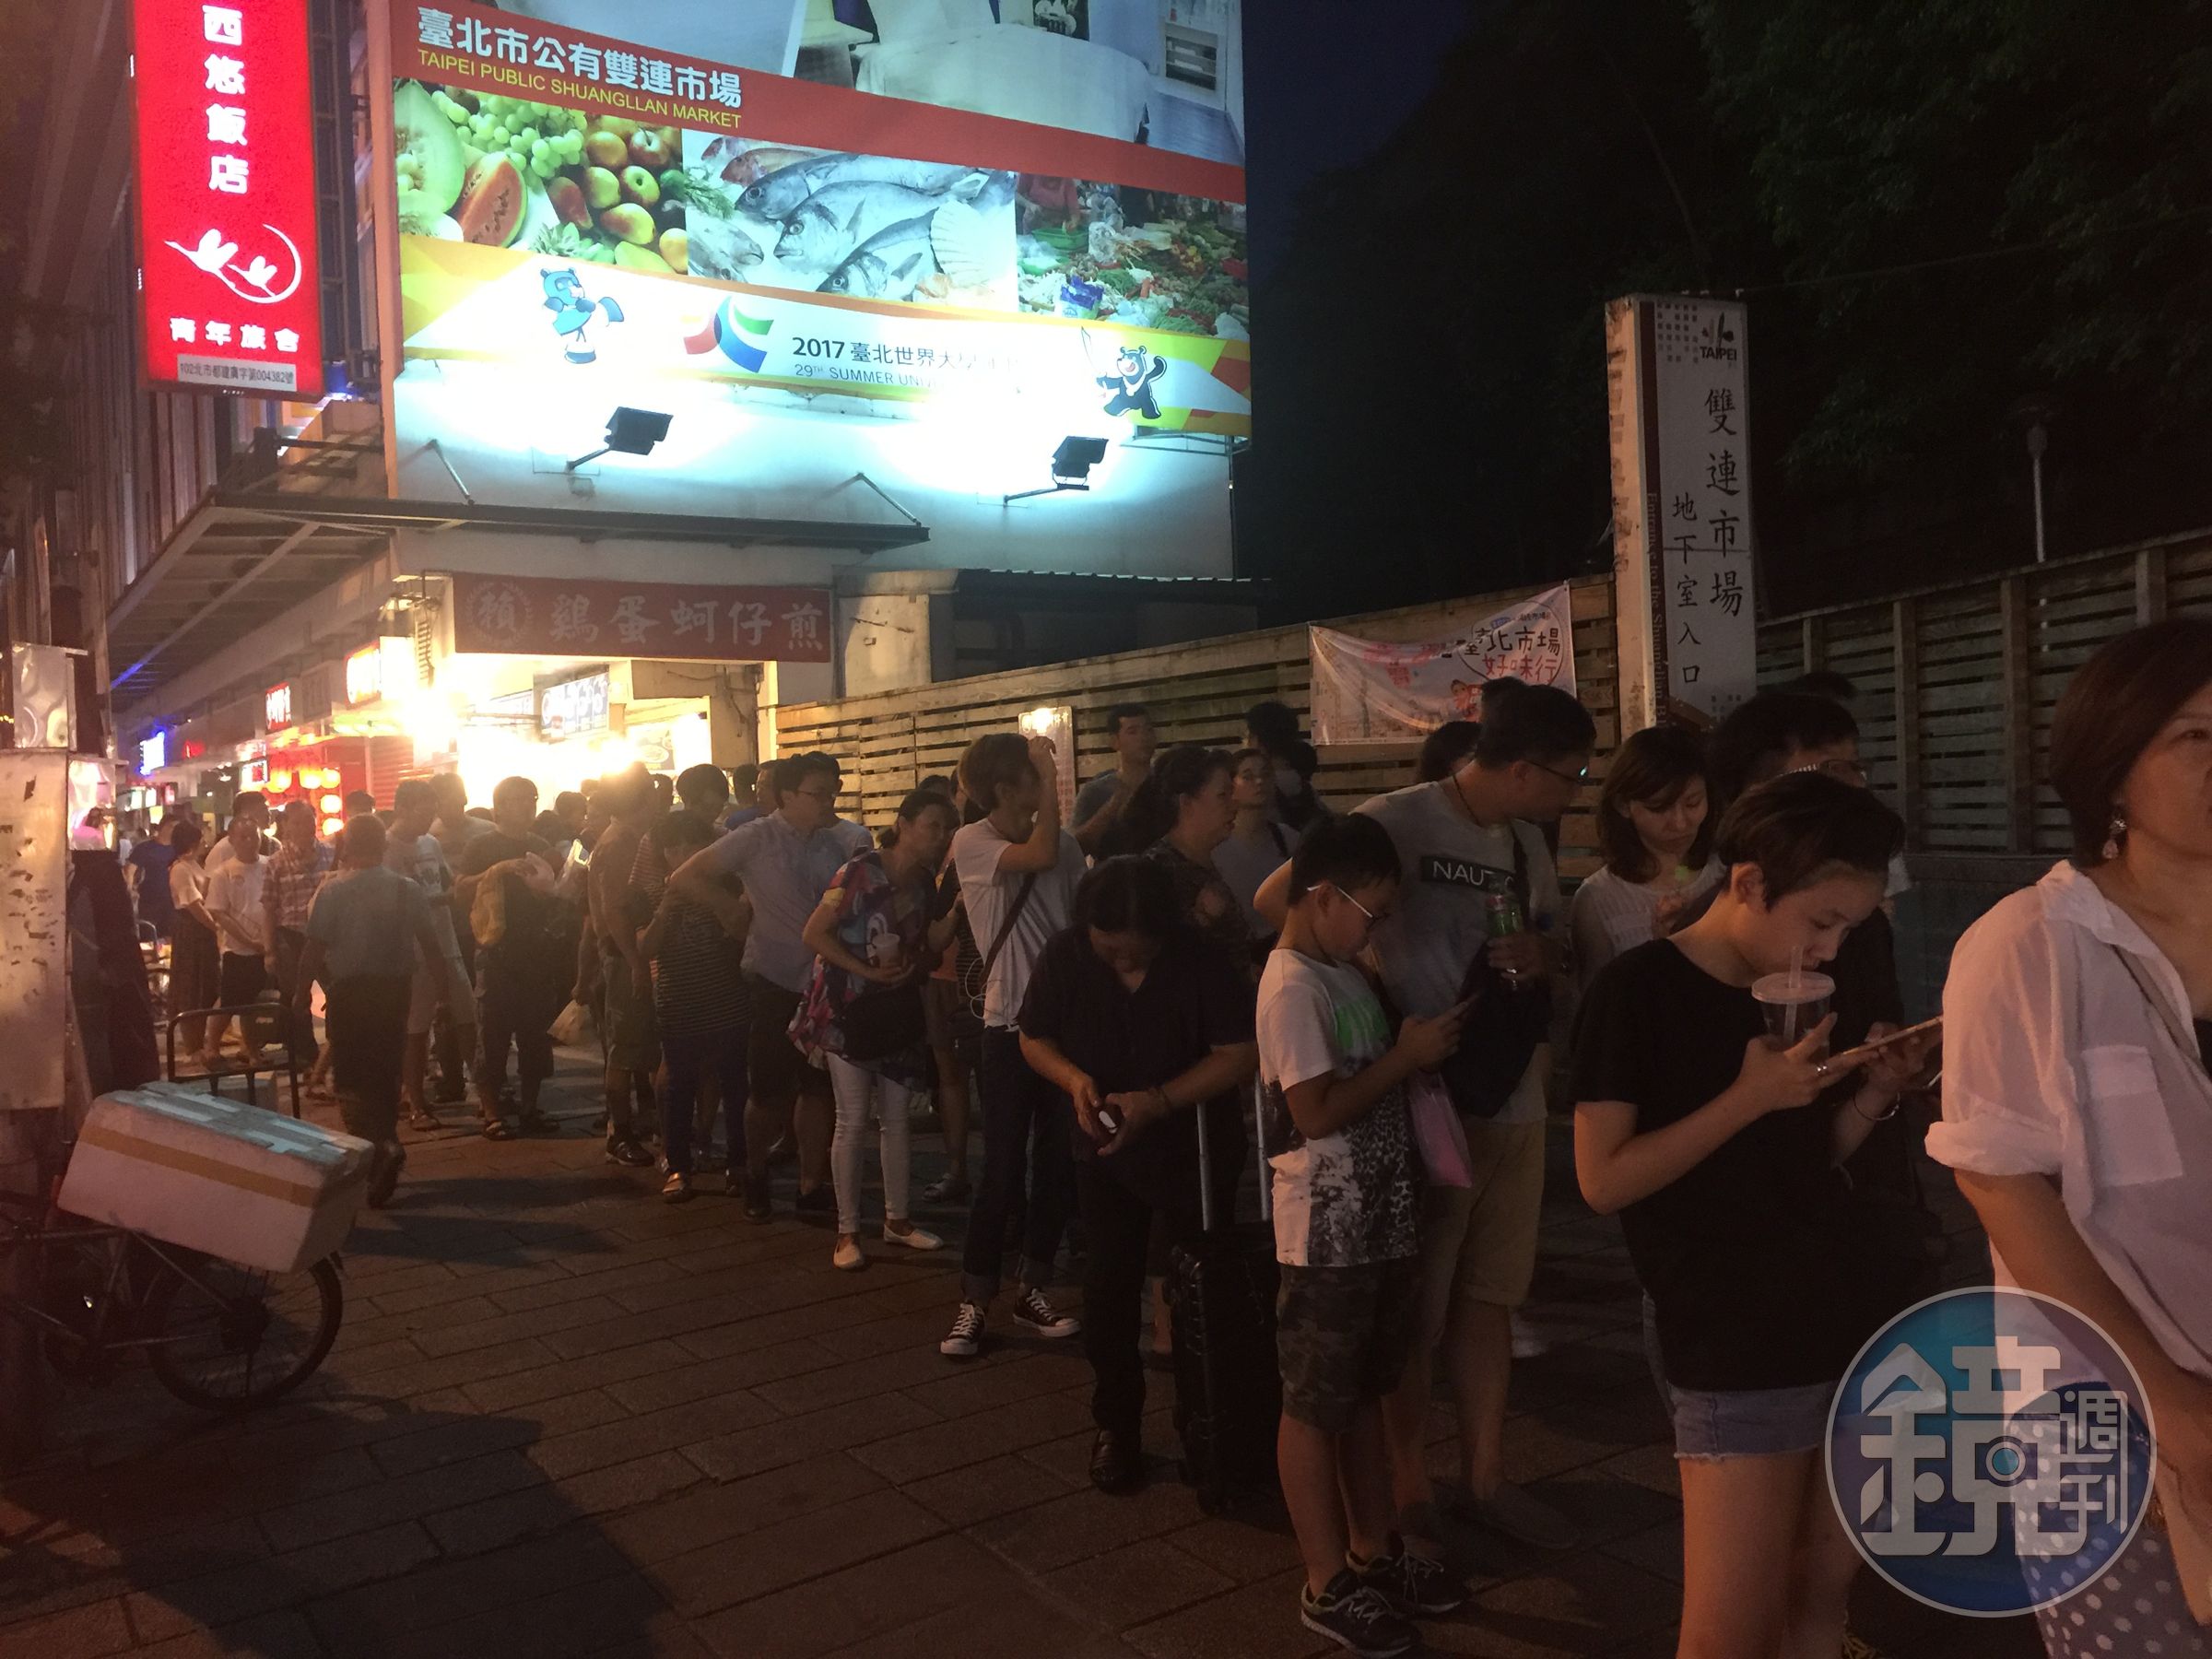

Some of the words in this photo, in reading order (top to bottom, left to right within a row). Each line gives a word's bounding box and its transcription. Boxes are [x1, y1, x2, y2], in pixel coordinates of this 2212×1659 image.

[418, 6, 743, 110] 臺北市公有雙連市場
[418, 48, 476, 77] TAIPEI
[480, 64, 546, 91] PUBLIC
[673, 103, 742, 129] MARKET
[201, 4, 249, 194] 西悠飯店
[792, 336, 846, 359] 2017
[830, 366, 894, 385] SUMMER
[1700, 346, 1737, 362] TAIPEI
[1704, 387, 1744, 618] 雙連市場
[1651, 586, 1661, 609] the
[1673, 491, 1701, 686] 地下室入口
